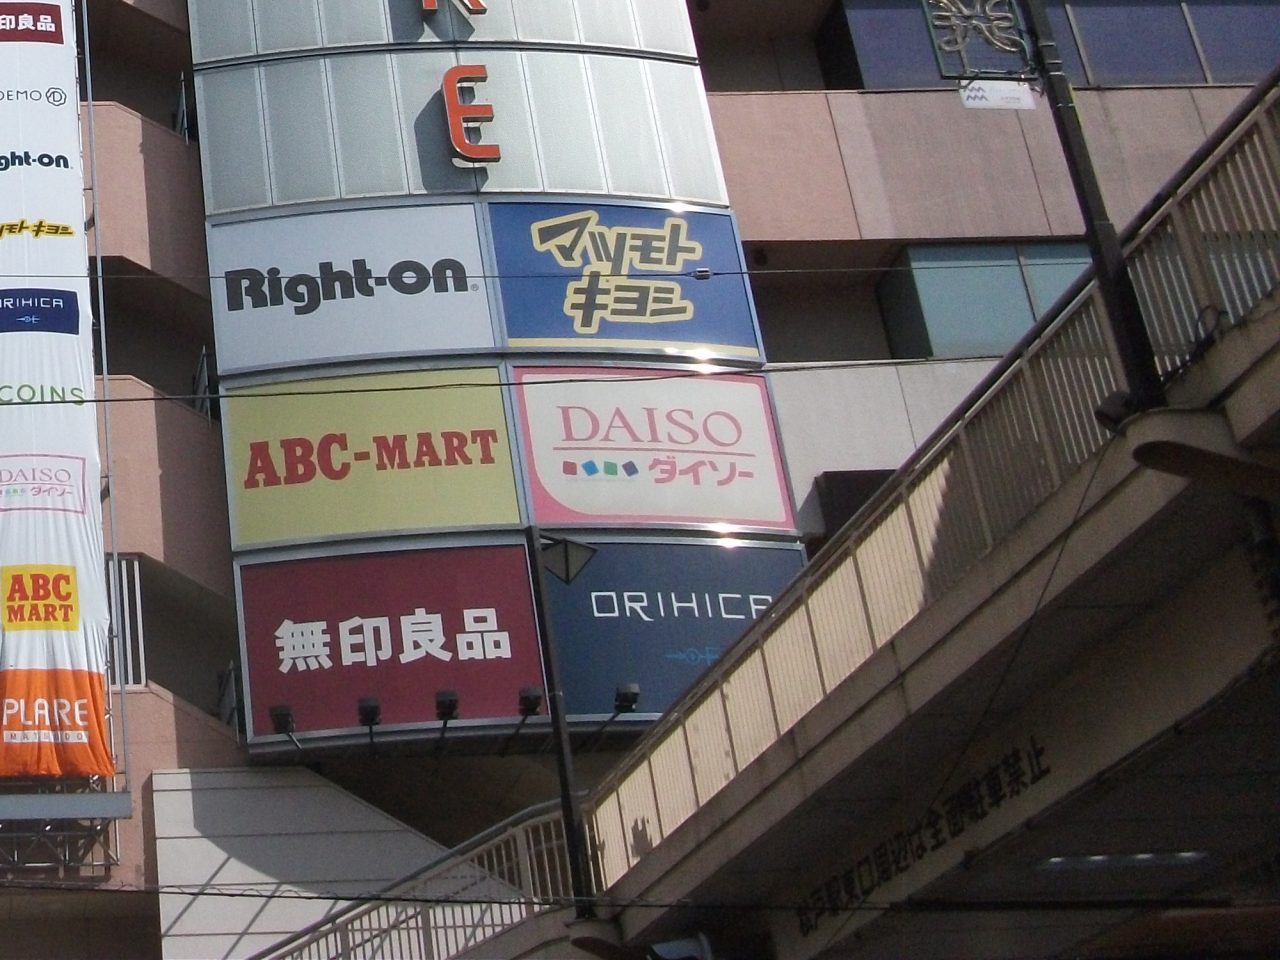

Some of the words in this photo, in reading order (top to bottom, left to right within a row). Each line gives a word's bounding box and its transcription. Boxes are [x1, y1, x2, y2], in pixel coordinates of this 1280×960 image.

[556, 406, 742, 447] DAISO
[243, 429, 498, 489] ABC-MART
[648, 456, 754, 486] ダイソー
[6, 573, 72, 602] ABC
[6, 604, 74, 622] MART
[275, 607, 511, 673] 無印良品
[2, 698, 88, 726] PLARE
